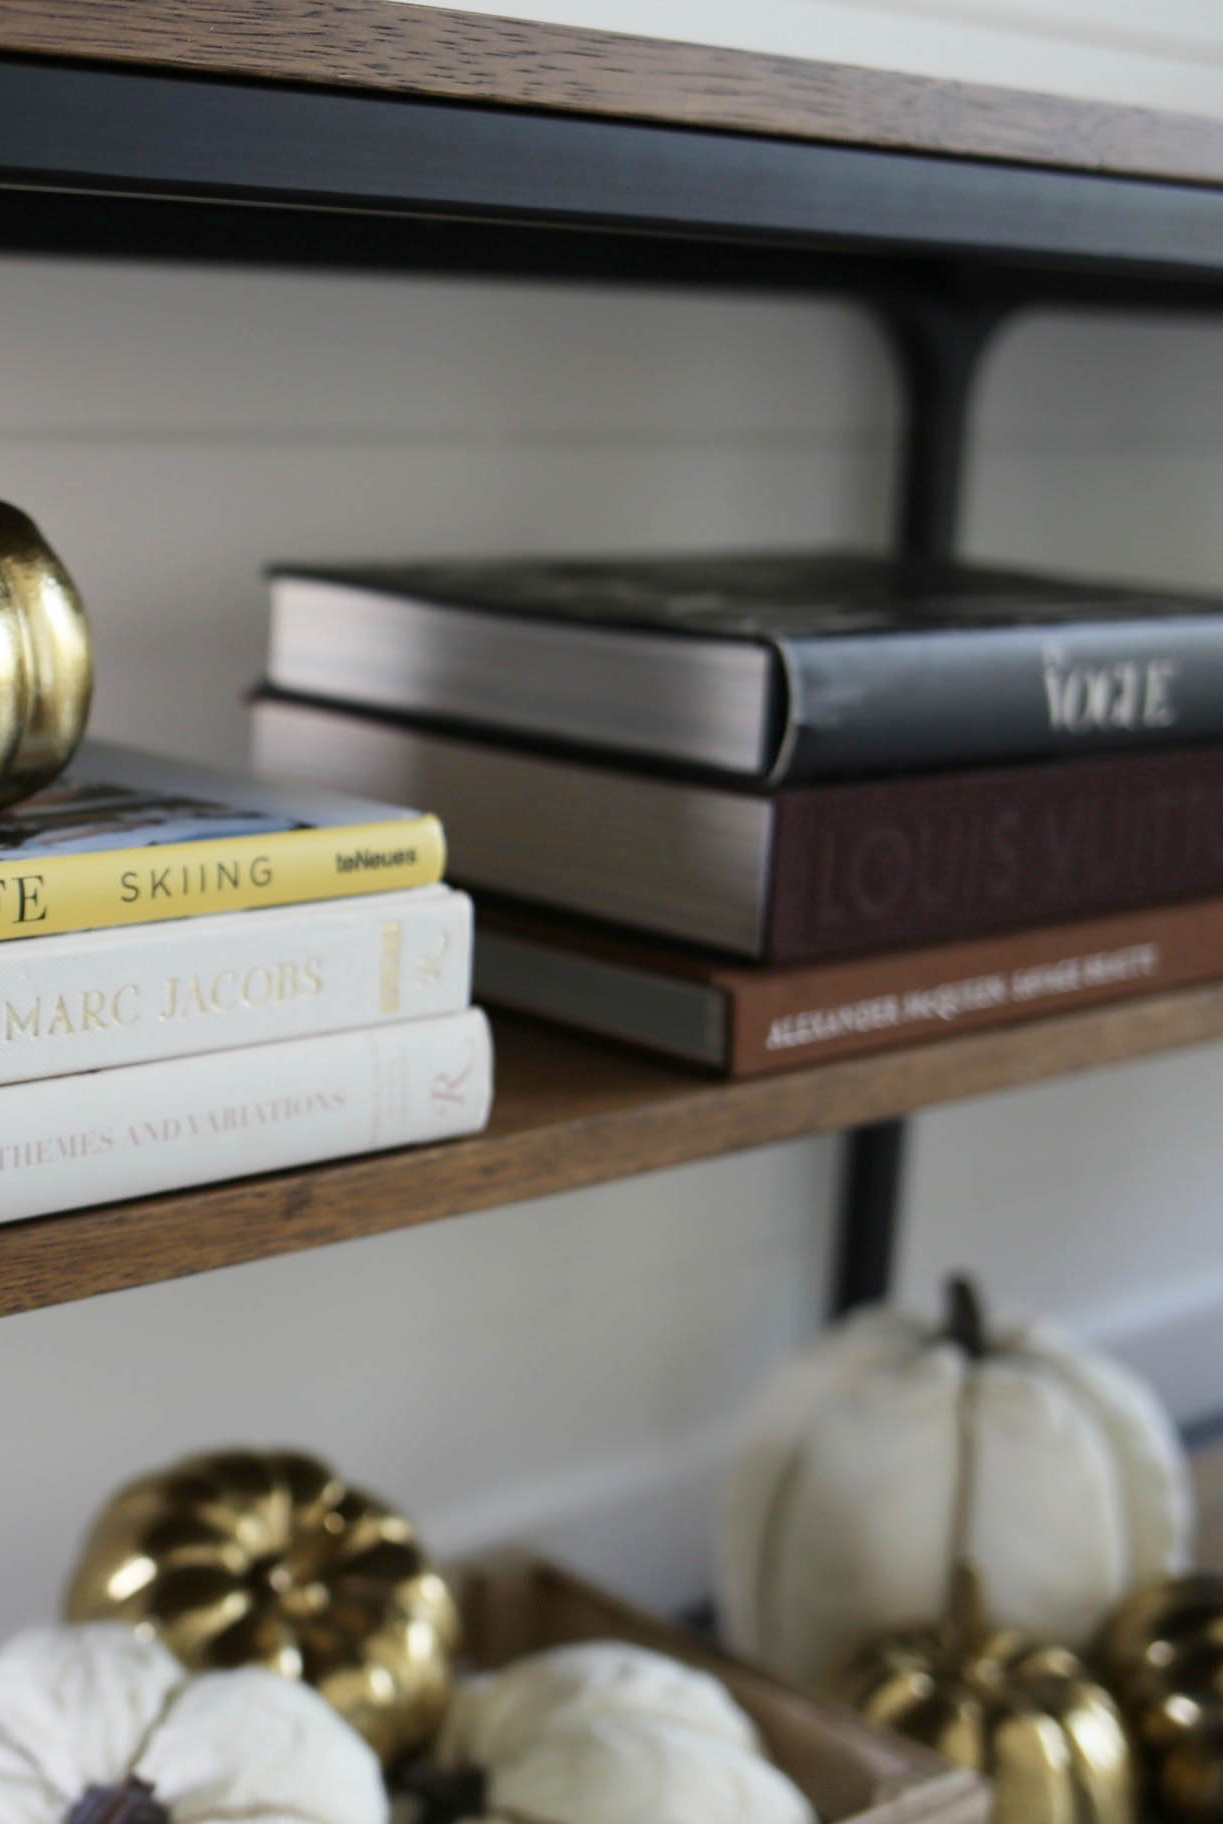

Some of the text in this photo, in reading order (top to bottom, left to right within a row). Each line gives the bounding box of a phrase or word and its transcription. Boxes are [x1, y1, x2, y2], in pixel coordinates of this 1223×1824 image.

[120, 856, 273, 903] SKIING
[5, 983, 139, 1042] MARC
[159, 956, 325, 1022] JACOBS
[126, 1117, 182, 1148] AND
[186, 1090, 346, 1137] VARIATIONS
